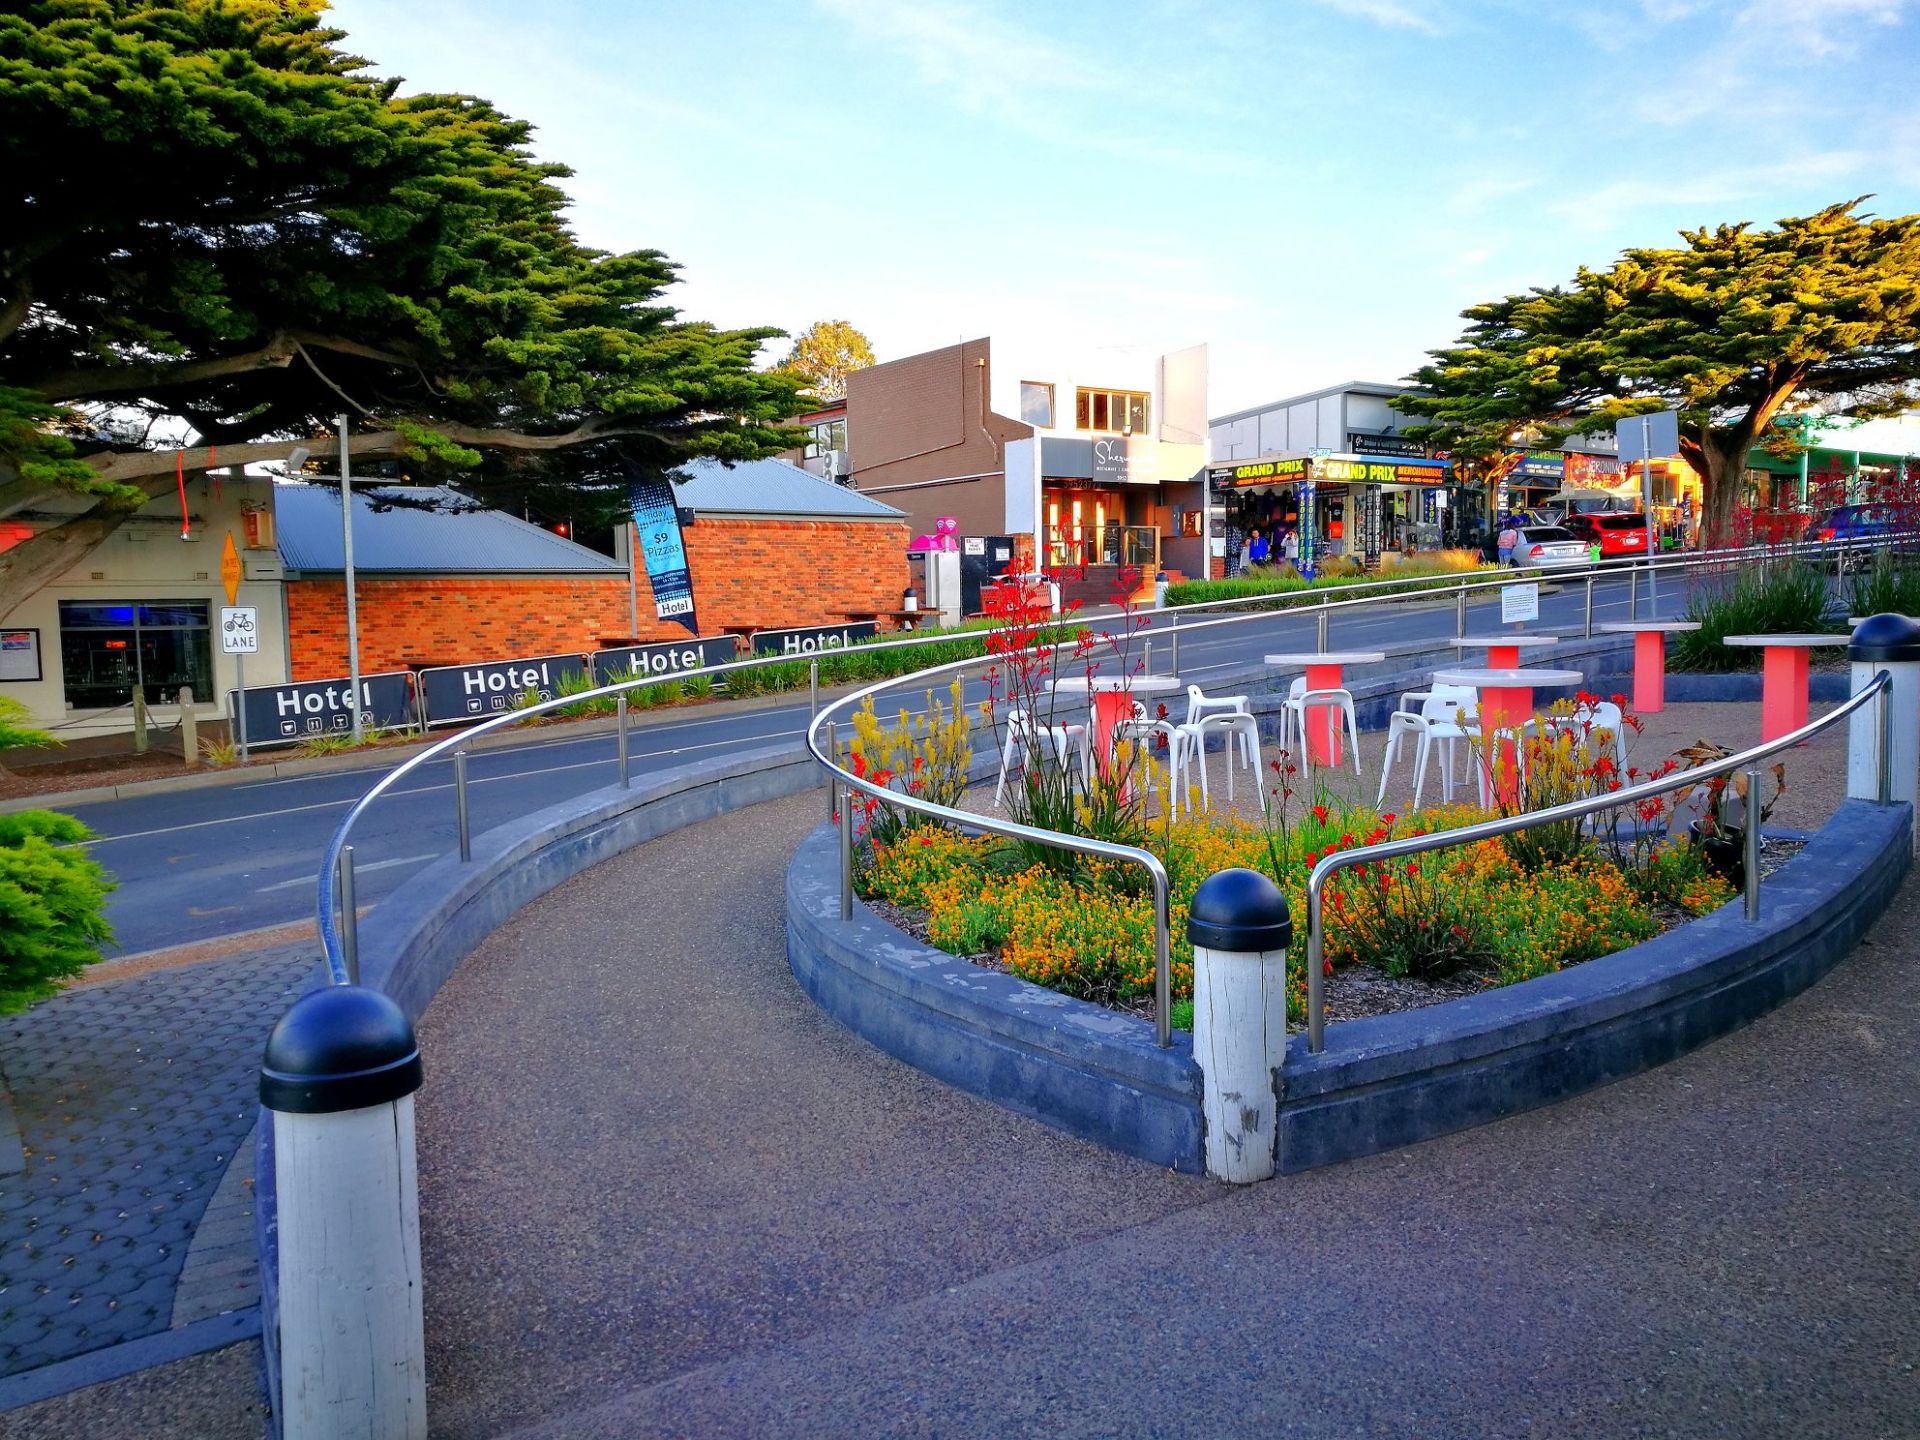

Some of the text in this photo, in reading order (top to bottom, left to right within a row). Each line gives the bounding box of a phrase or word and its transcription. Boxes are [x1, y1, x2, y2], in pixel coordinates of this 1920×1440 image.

[1237, 463, 1274, 478] GRAND
[1277, 460, 1304, 473] PRIX
[1327, 462, 1366, 480] GRAND
[1370, 465, 1396, 481] PRIX
[1397, 466, 1443, 477] MERCHANDISE
[654, 533, 668, 544] $9
[647, 543, 680, 558] Pizzas
[661, 600, 688, 614] Hotel
[224, 636, 255, 648] LANE
[783, 629, 848, 656] Hotel
[629, 645, 706, 674] Hotel
[463, 662, 550, 695] Hotel
[277, 682, 371, 716] Hotel
